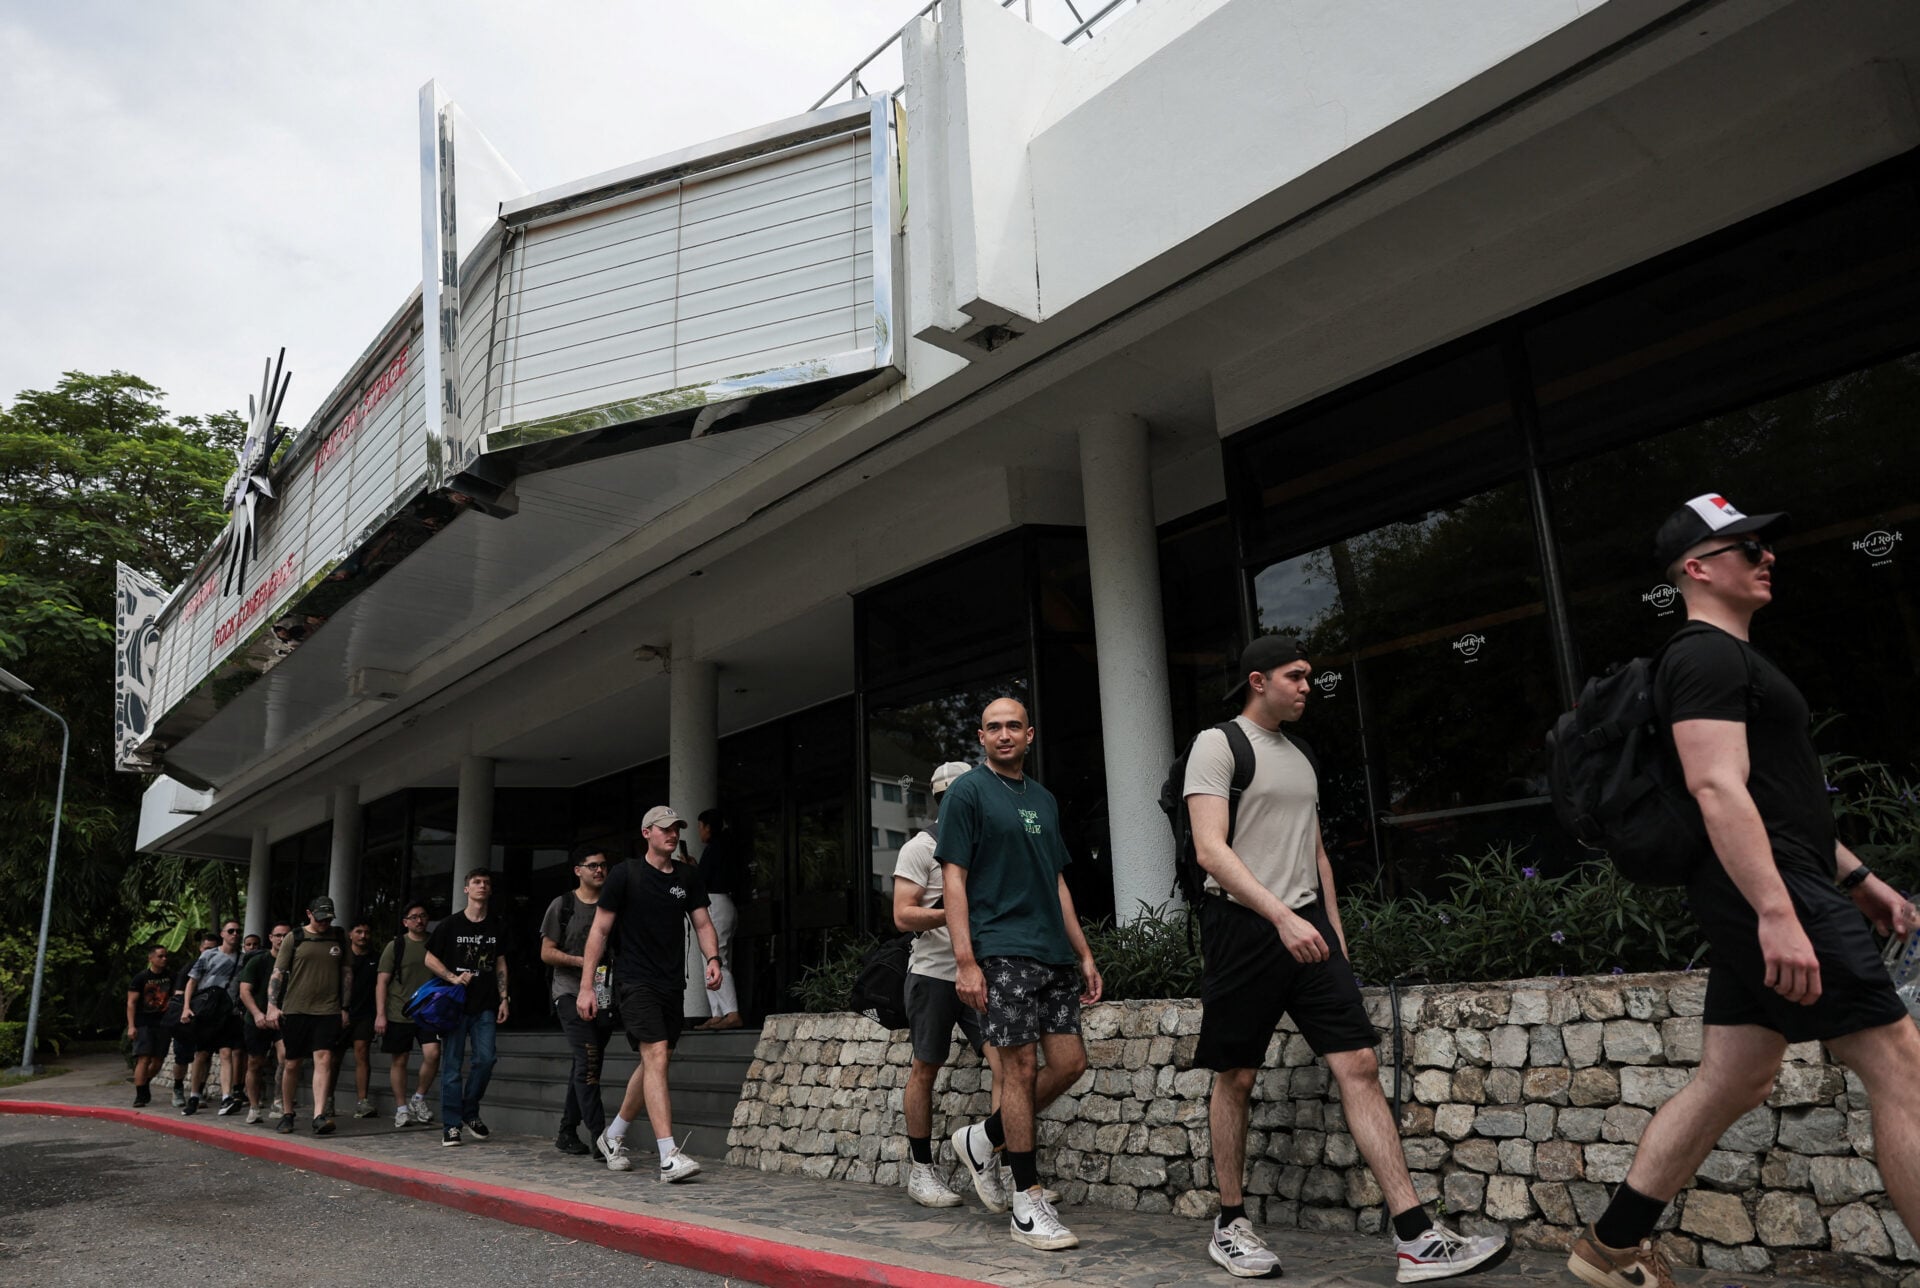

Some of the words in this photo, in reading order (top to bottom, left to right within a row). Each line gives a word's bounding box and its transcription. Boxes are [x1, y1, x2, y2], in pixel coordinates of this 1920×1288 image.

[362, 344, 409, 418] STAGE
[1852, 537, 1877, 551] Hard
[1878, 530, 1903, 545] Rock
[1642, 589, 1661, 602] Hard
[213, 613, 237, 651] ROCK
[1453, 638, 1469, 650] Hard
[1314, 676, 1328, 686] Hard
[456, 935, 497, 945] anxius
